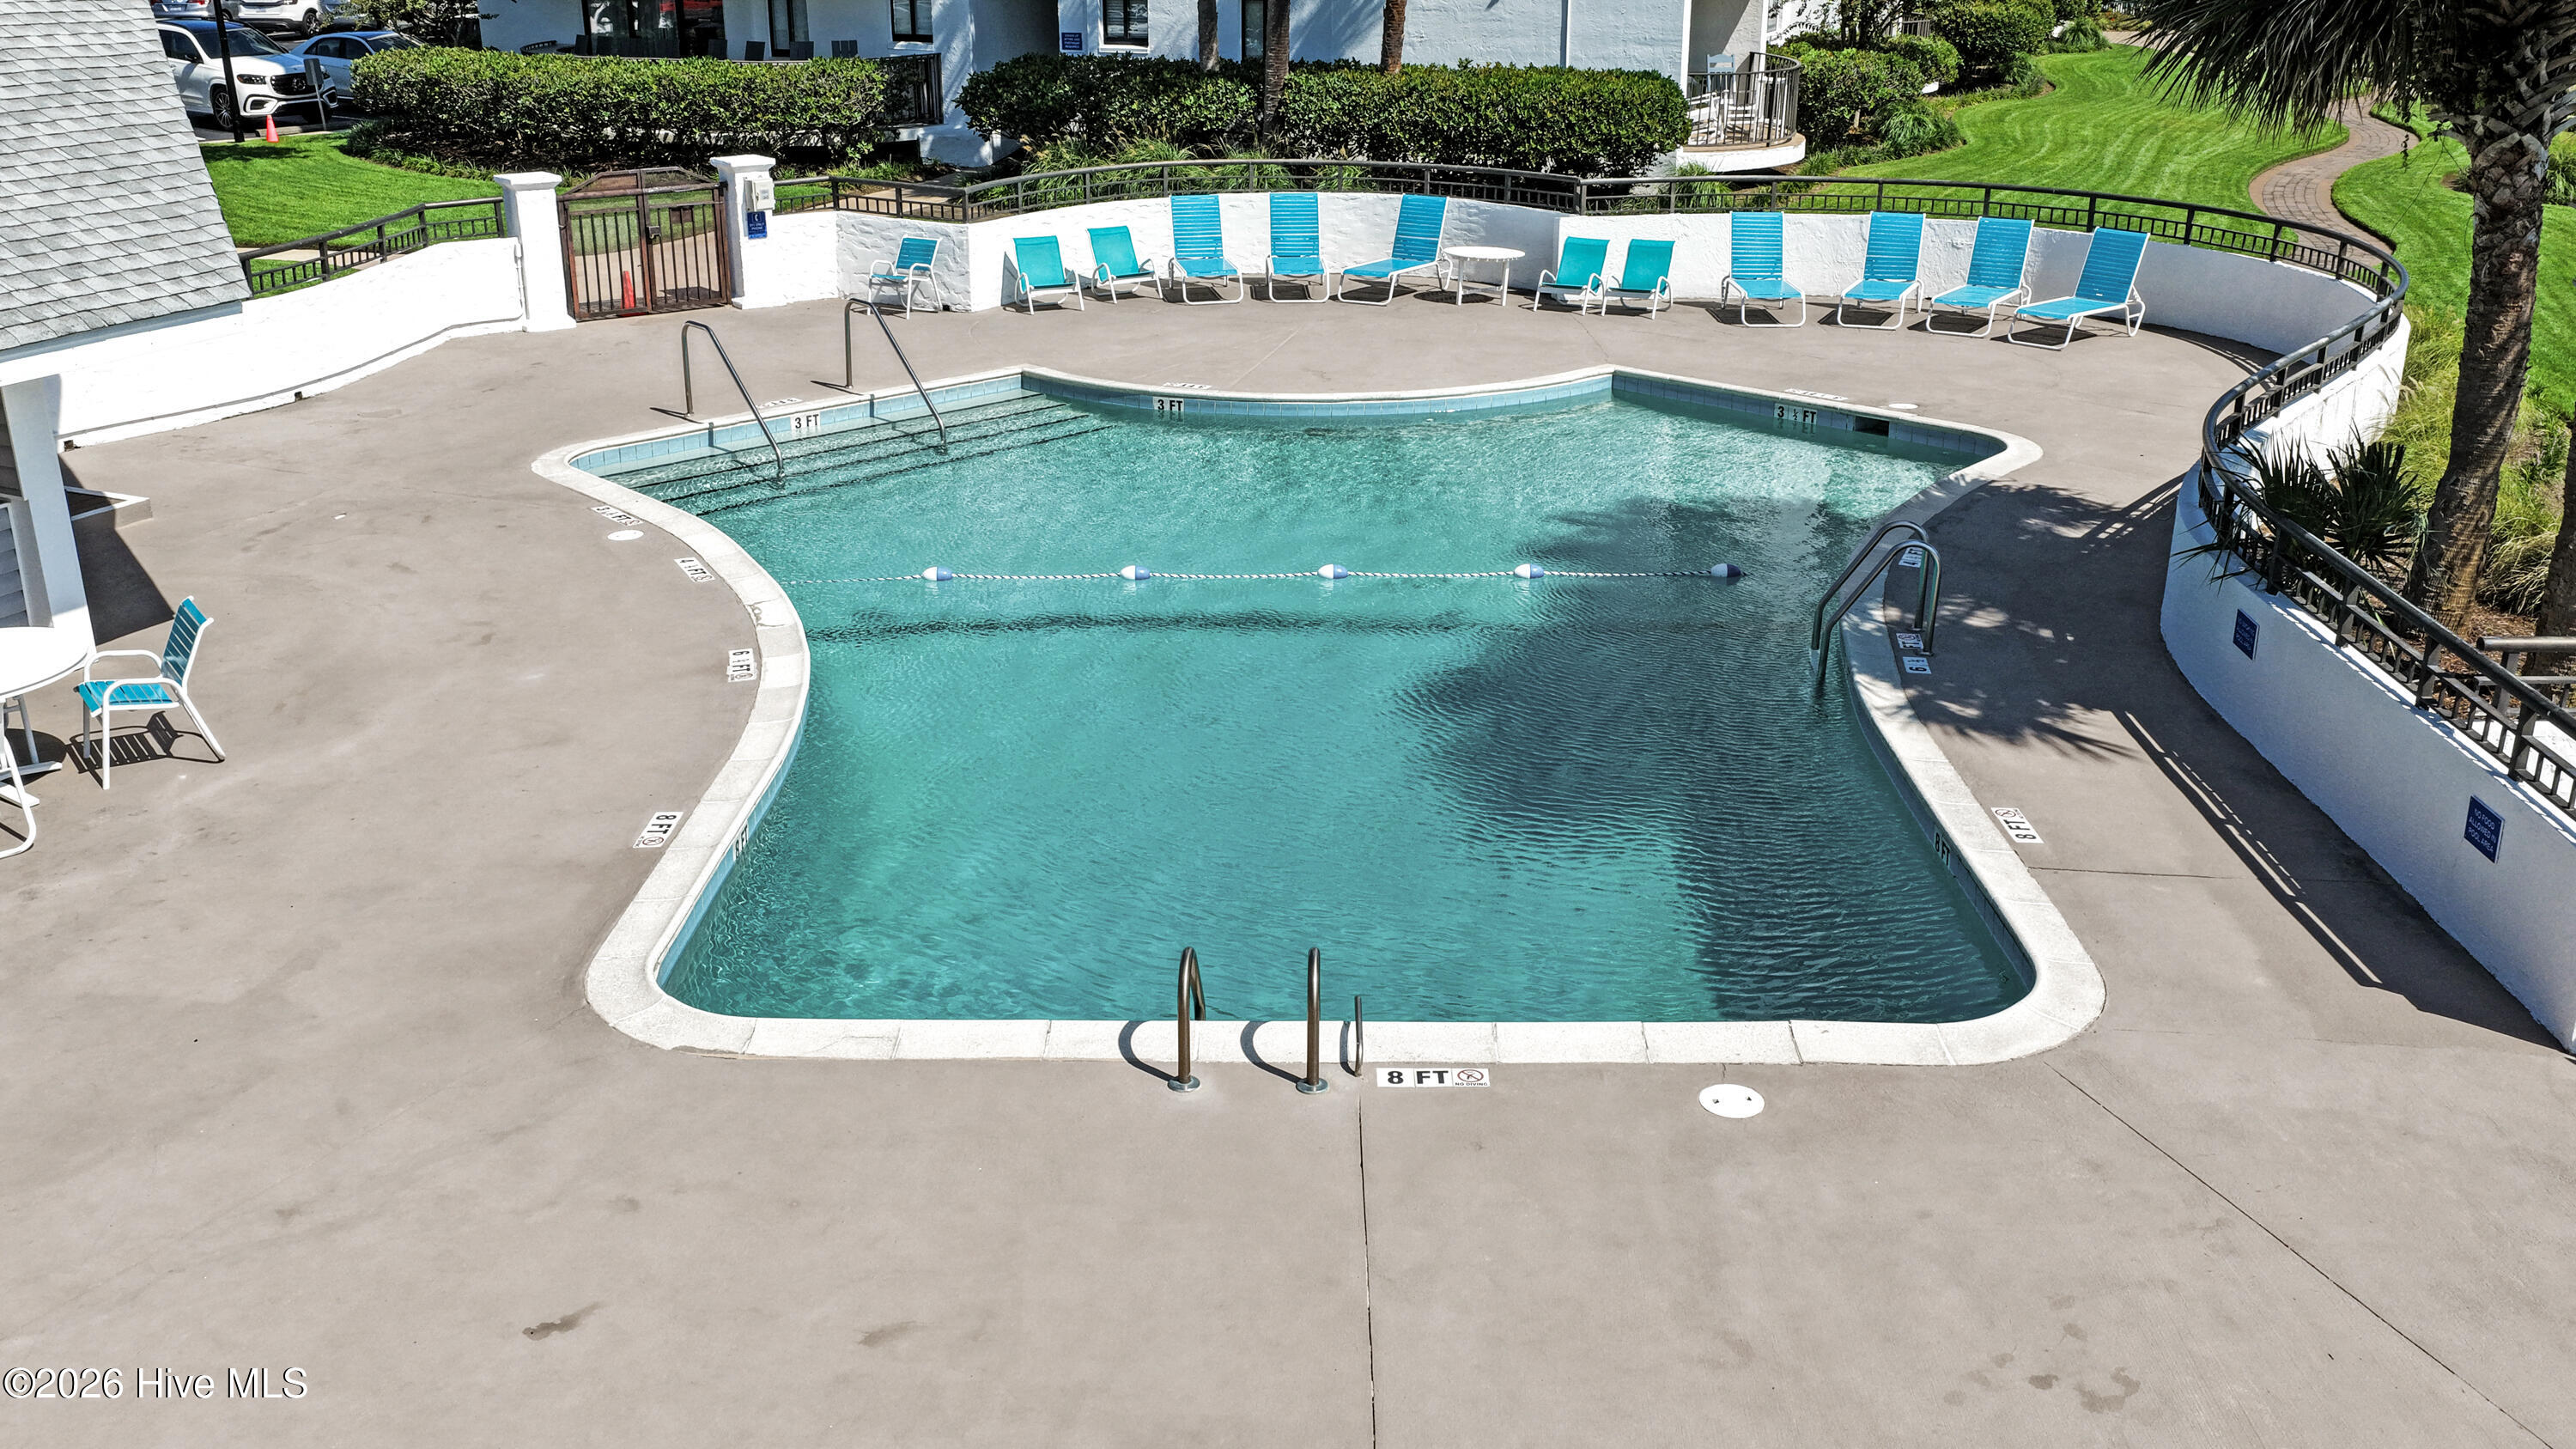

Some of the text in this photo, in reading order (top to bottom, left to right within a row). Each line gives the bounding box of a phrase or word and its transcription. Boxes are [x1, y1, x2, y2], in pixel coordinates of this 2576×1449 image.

[1157, 399, 1183, 411] 3 FT
[794, 414, 819, 429] 3 FT
[1777, 405, 1785, 418] 3
[1803, 410, 1816, 423] FT
[647, 823, 673, 835] FT
[2003, 819, 2031, 831] FT
[2469, 816, 2491, 839] ALLOWED
[2482, 814, 2495, 830] FOOD
[740, 824, 749, 849] FT
[2468, 827, 2494, 852] POOL AREA
[1941, 841, 1951, 867] FT
[1387, 1070, 1449, 1085] 8 FT
